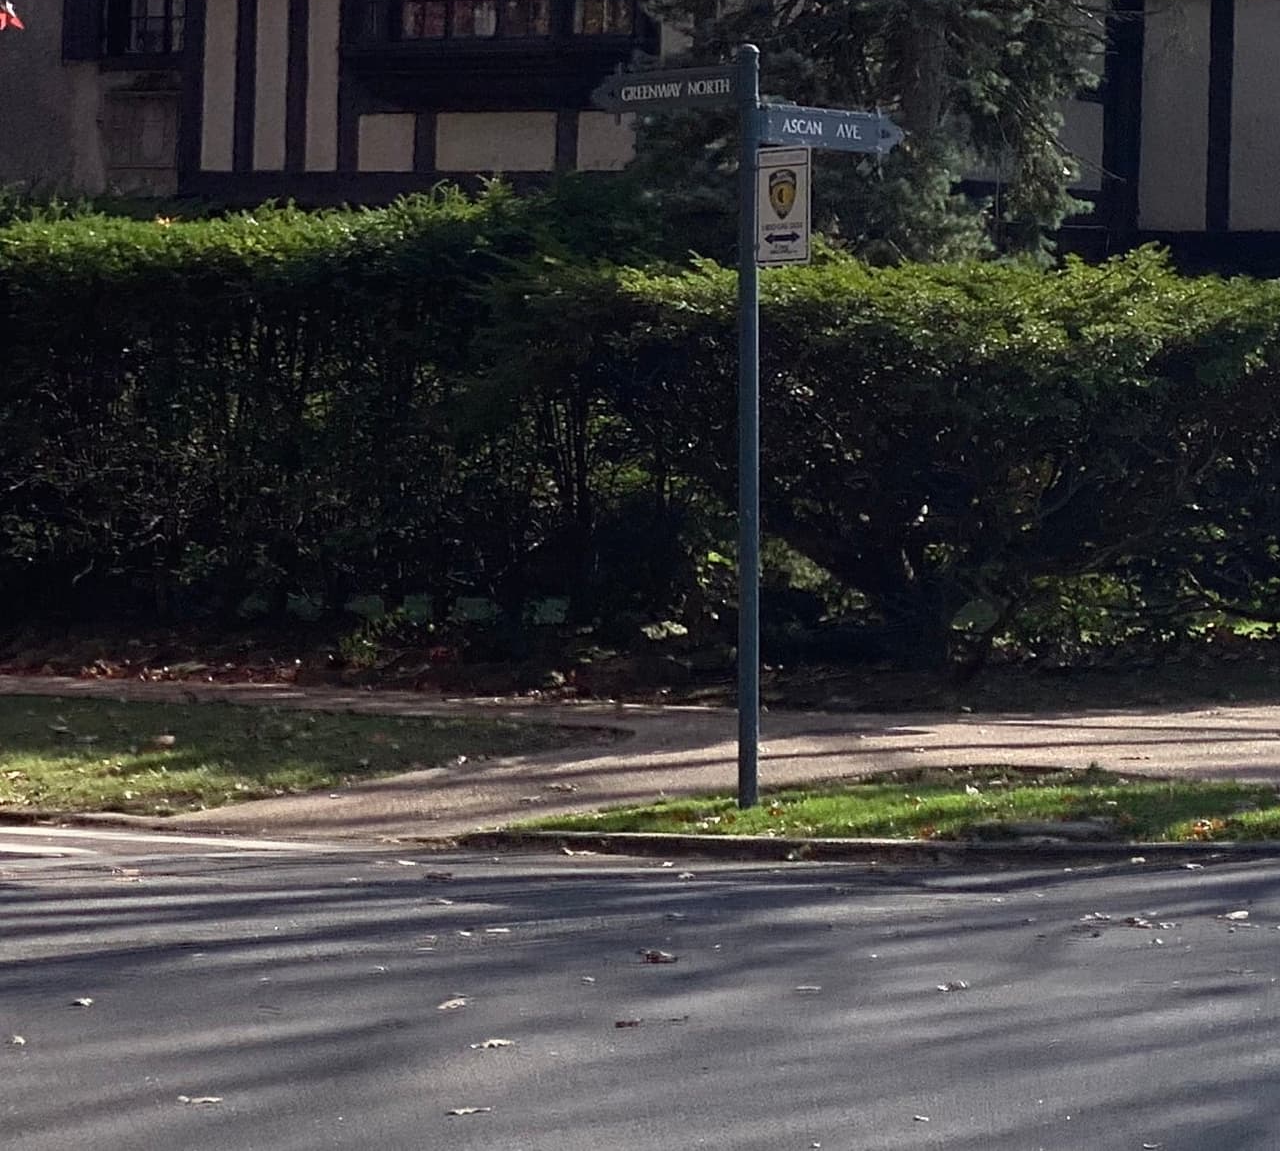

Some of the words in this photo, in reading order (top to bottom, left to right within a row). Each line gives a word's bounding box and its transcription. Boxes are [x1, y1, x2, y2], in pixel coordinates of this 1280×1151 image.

[621, 82, 682, 102] GREENWAY
[687, 78, 730, 96] NORTH
[782, 118, 823, 136] ASCAN
